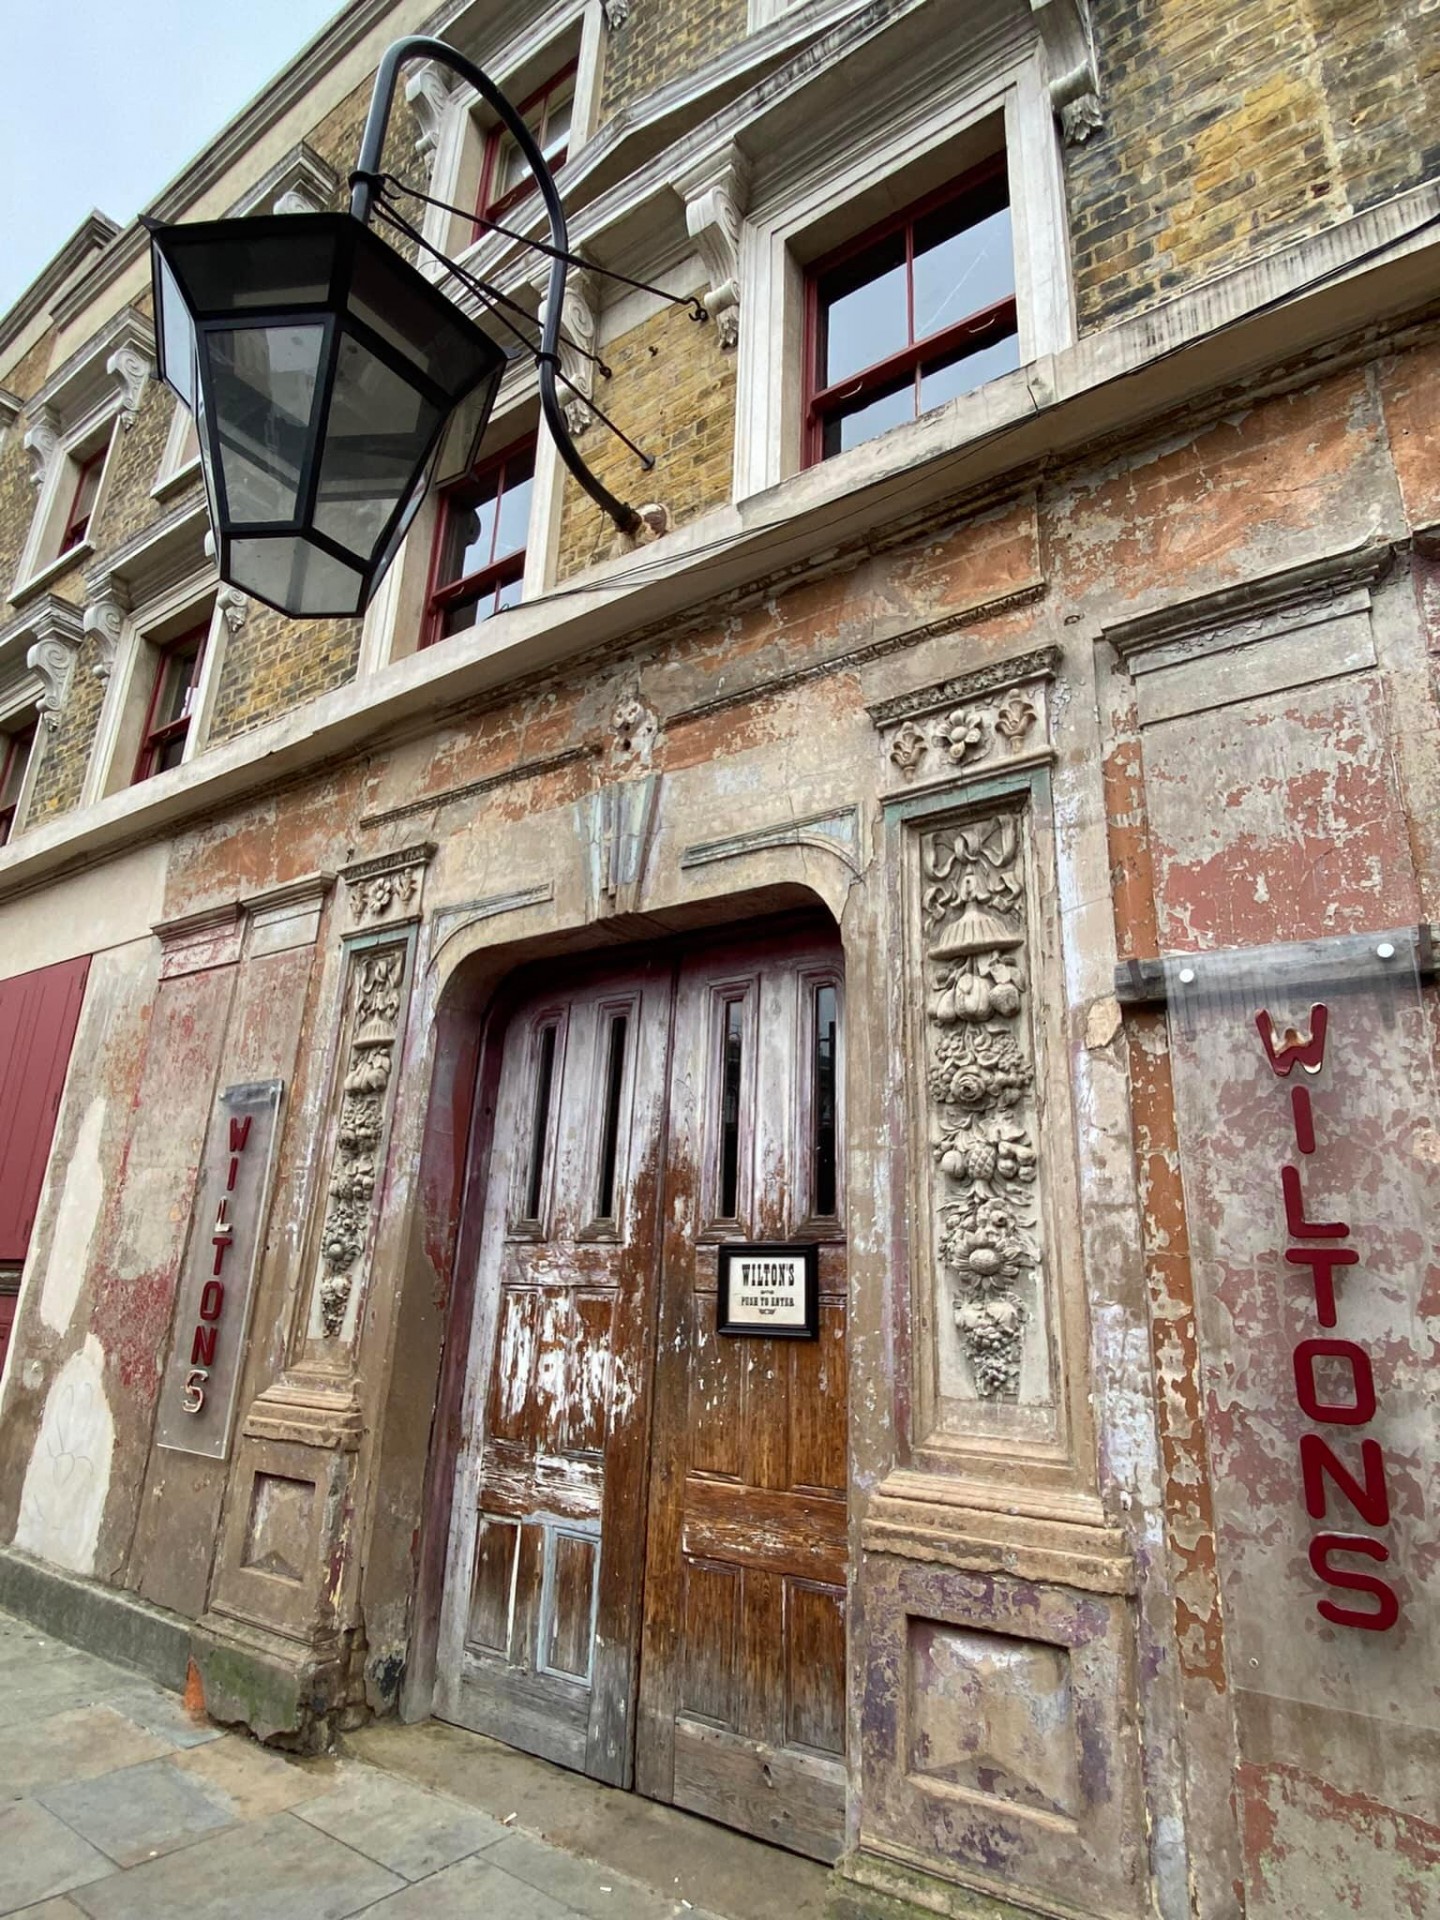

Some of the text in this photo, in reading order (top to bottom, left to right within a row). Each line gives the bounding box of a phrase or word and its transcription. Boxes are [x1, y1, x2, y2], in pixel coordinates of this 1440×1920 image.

[182, 1115, 252, 1414] WILTONS
[741, 1263, 795, 1287] WILTON'S
[760, 1296, 769, 1306] TO
[1255, 1002, 1399, 1631] WILTONS
